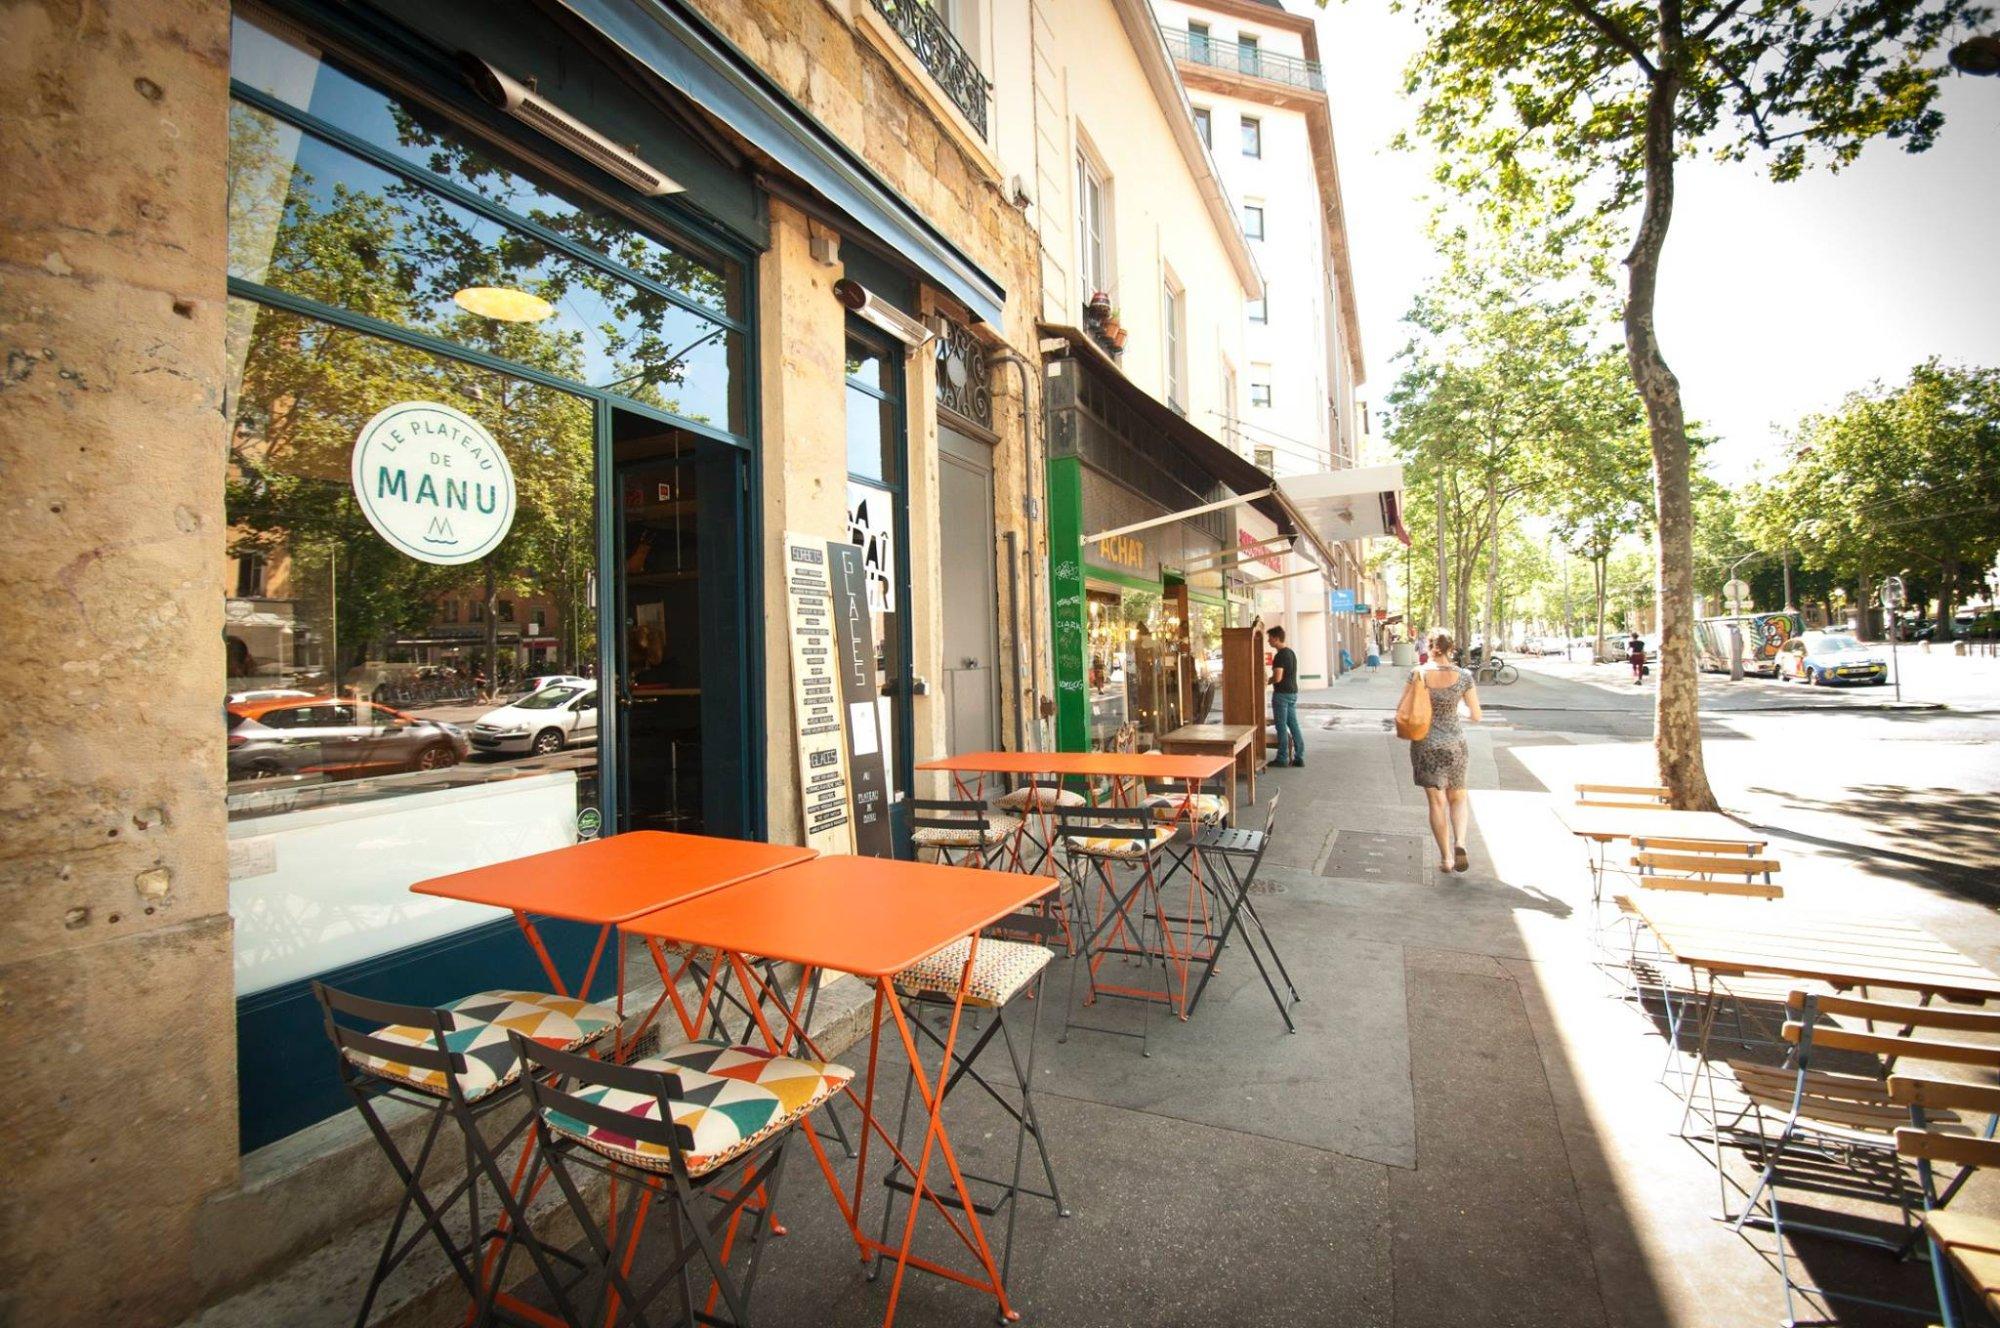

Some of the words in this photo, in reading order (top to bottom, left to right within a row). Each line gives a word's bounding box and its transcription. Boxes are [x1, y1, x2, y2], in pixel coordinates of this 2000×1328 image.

[382, 429, 405, 452] LE
[410, 420, 493, 471] PLATEAU
[430, 452, 452, 467] DE
[378, 466, 496, 514] MANU
[1100, 531, 1144, 569] ACHAT
[842, 551, 865, 686] GLACES
[811, 751, 837, 767] GLACES
